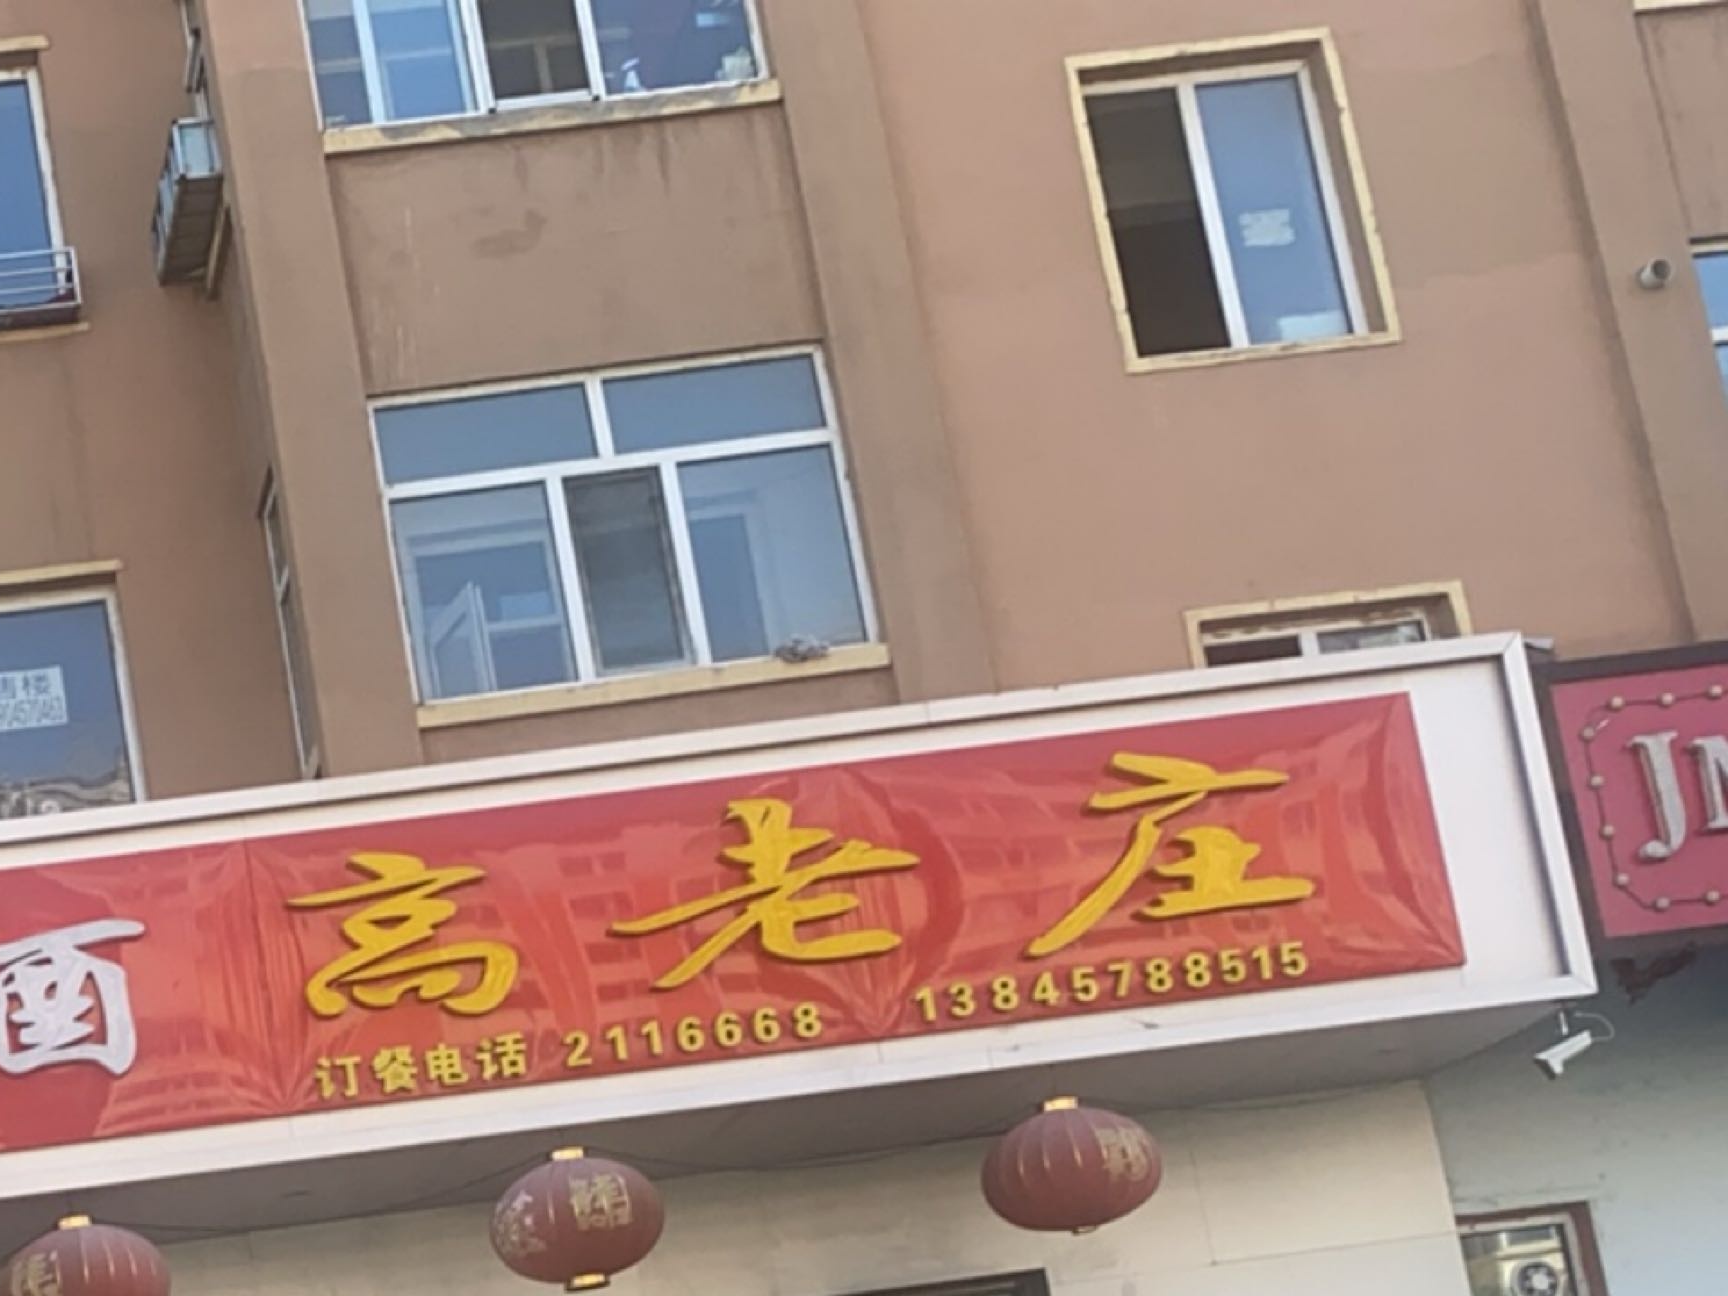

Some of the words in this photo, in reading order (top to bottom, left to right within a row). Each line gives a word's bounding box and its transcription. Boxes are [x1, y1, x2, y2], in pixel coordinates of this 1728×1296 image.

[286, 750, 1317, 1019] 高老庄
[315, 1033, 528, 1099] 订餐电话
[563, 1004, 824, 1067] 2116668
[915, 941, 1308, 1022] 13845788515
